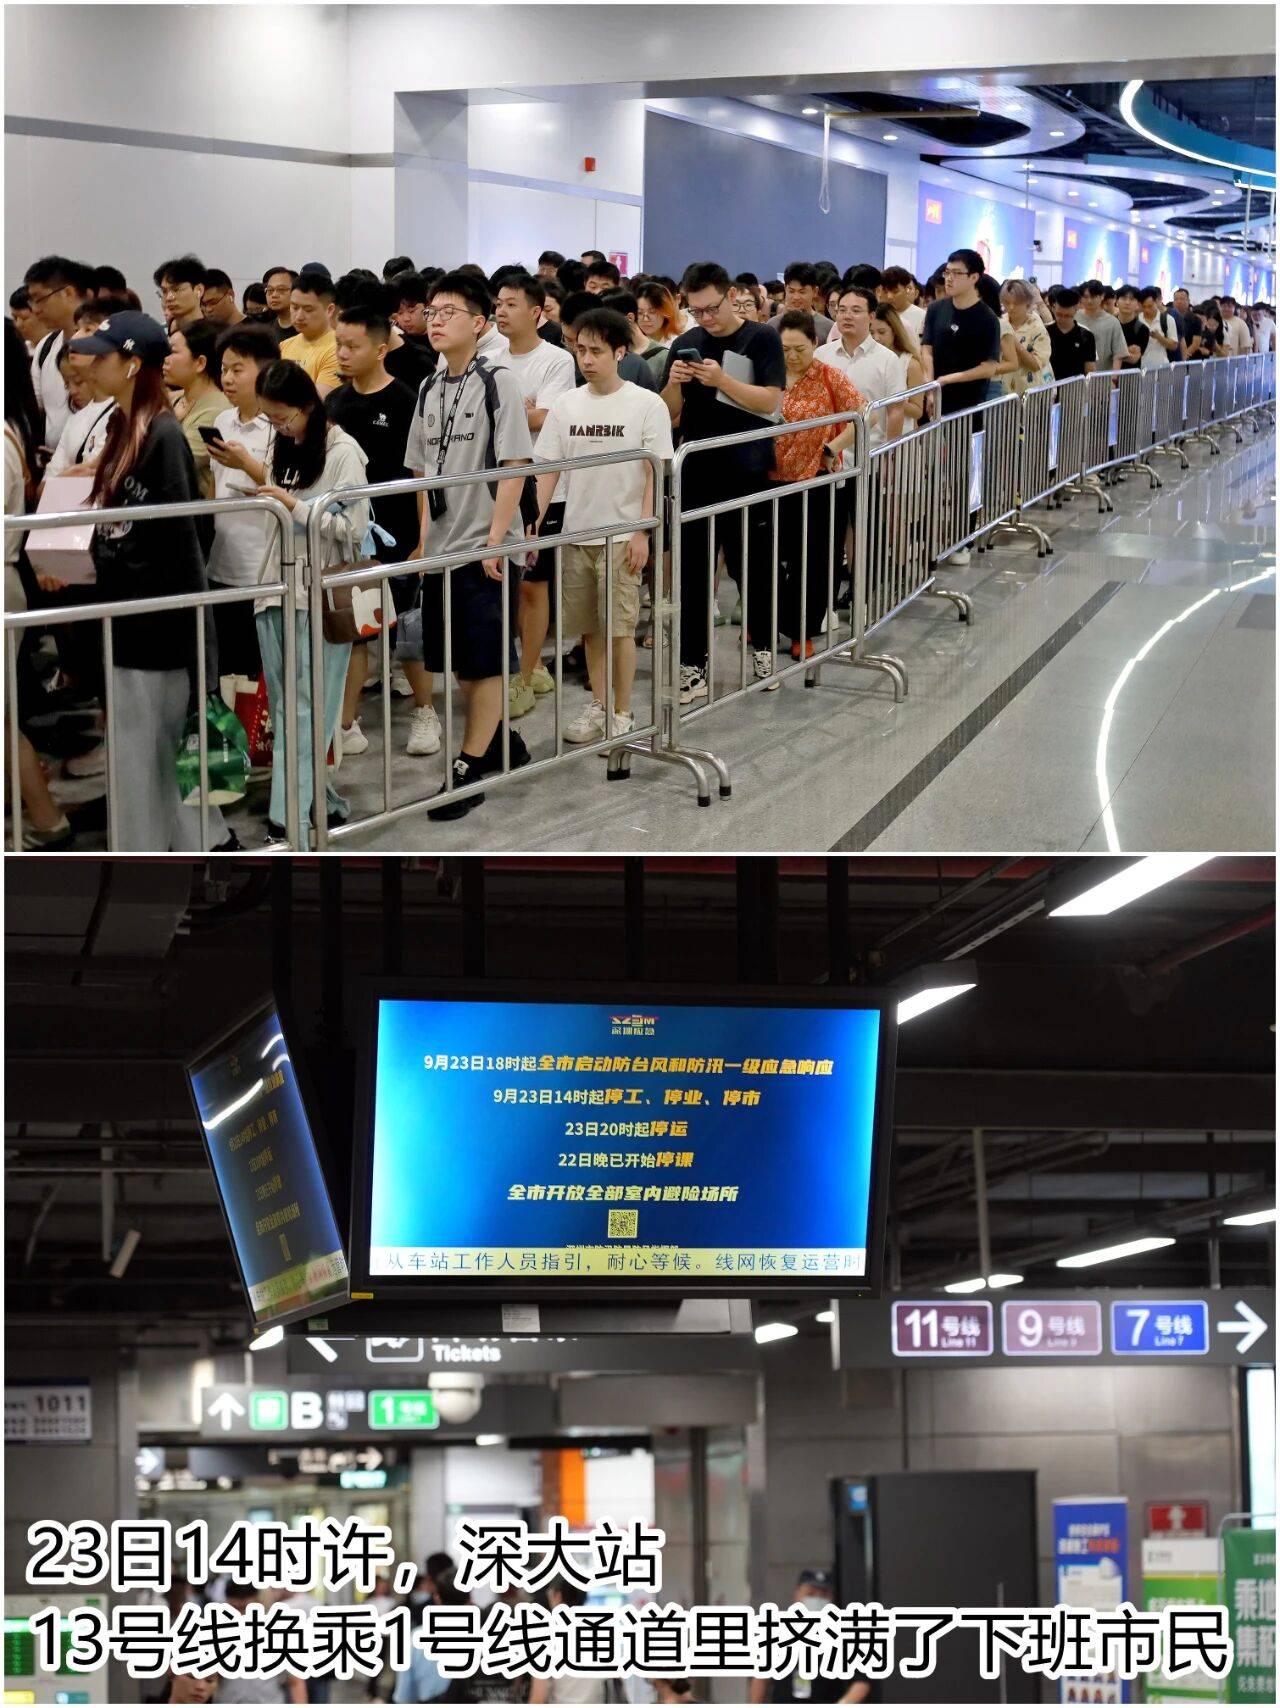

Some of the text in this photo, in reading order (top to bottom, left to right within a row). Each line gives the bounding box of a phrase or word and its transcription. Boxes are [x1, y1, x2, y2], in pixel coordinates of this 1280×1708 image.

[423, 1054, 834, 1076] 9月23日18时起全市启动防台风和防汛一级应急响应
[493, 1088, 761, 1106] 9月23日14时起停工、停业、停市
[565, 1120, 688, 1137] 23日20时起停运
[558, 1152, 694, 1168] 22日晚已开始停课
[507, 1184, 739, 1202] 全市开放全部室内避险场所
[433, 1344, 501, 1363] Tickets
[35, 1395, 85, 1412] 1011
